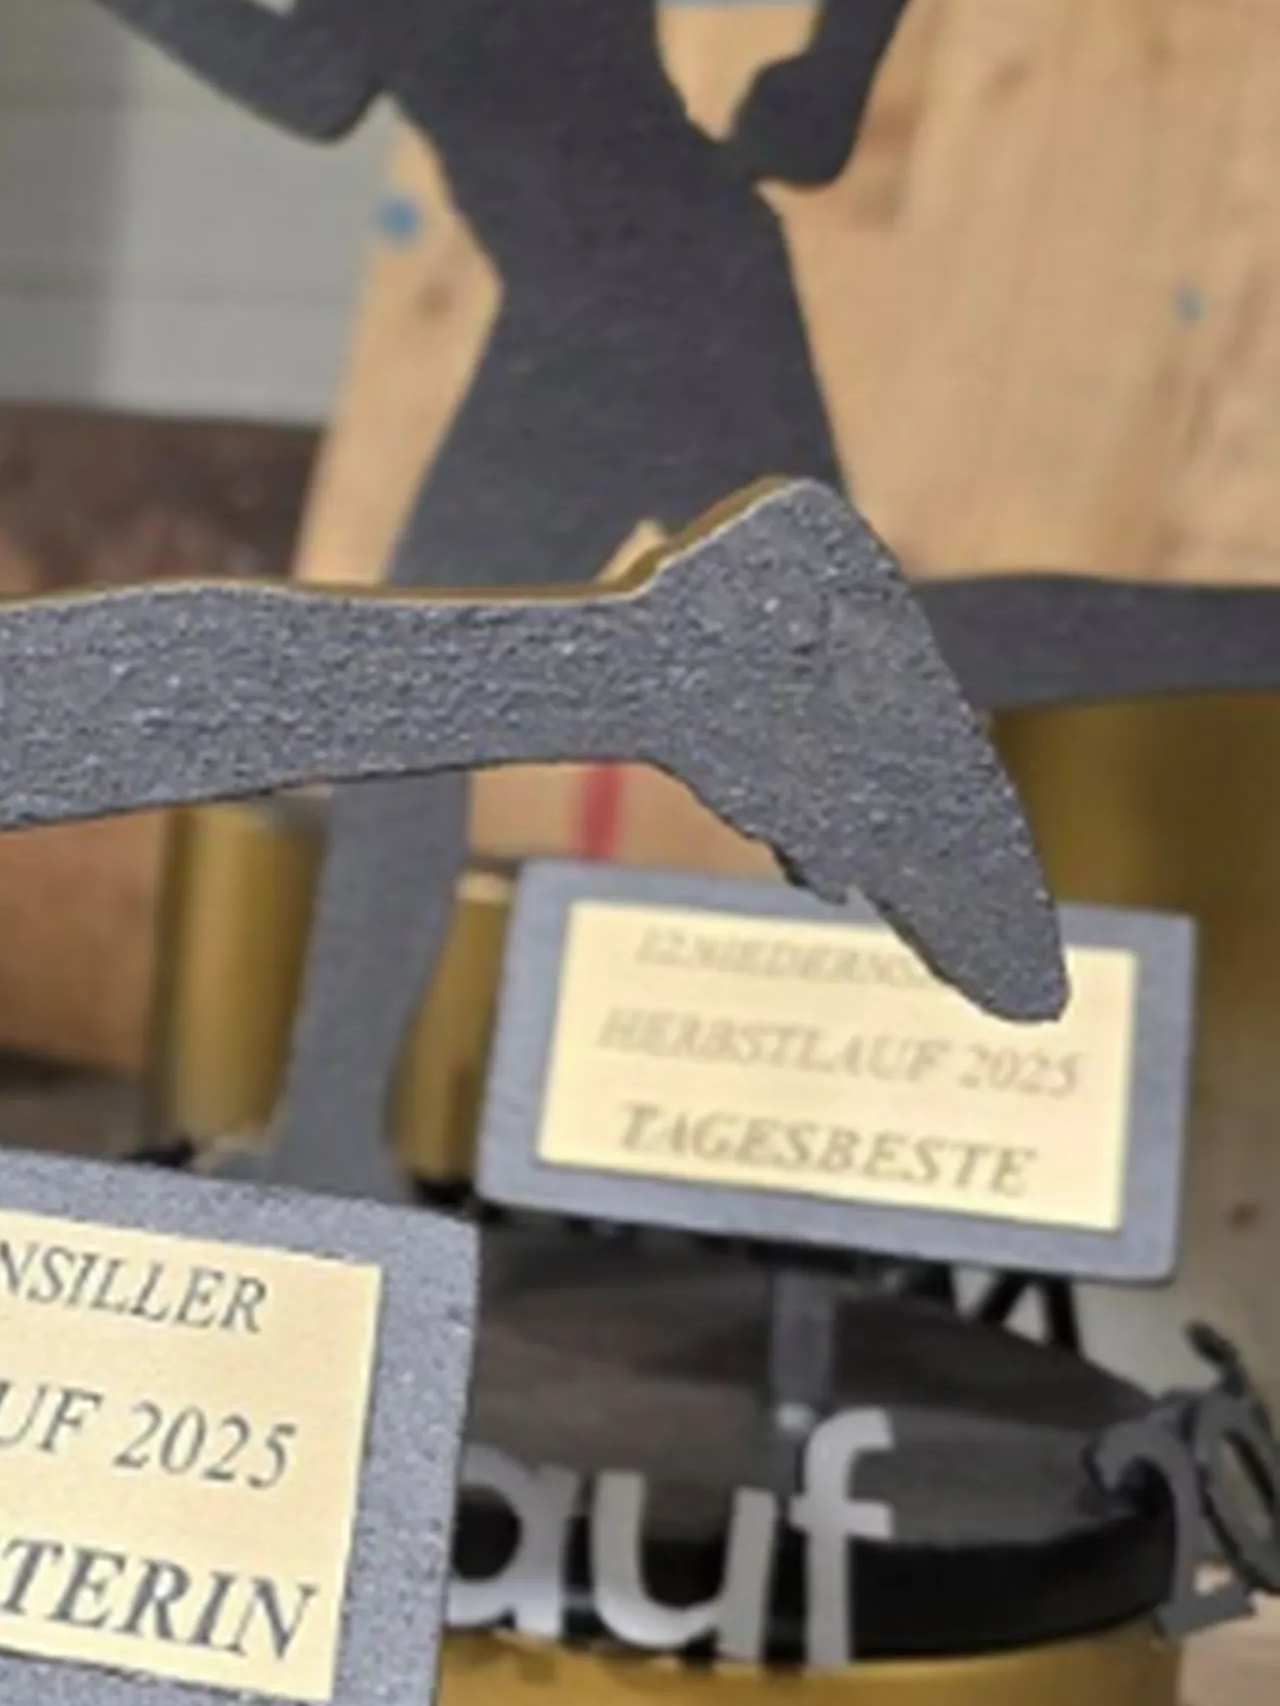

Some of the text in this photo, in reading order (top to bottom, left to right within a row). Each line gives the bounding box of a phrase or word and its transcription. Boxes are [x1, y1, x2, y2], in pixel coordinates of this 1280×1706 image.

[596, 1007, 1083, 1099] HERBSTLAUF 2025
[620, 1100, 1038, 1198] TAGESBESTE
[112, 1402, 296, 1490] 2025
[446, 1406, 894, 1669] auf
